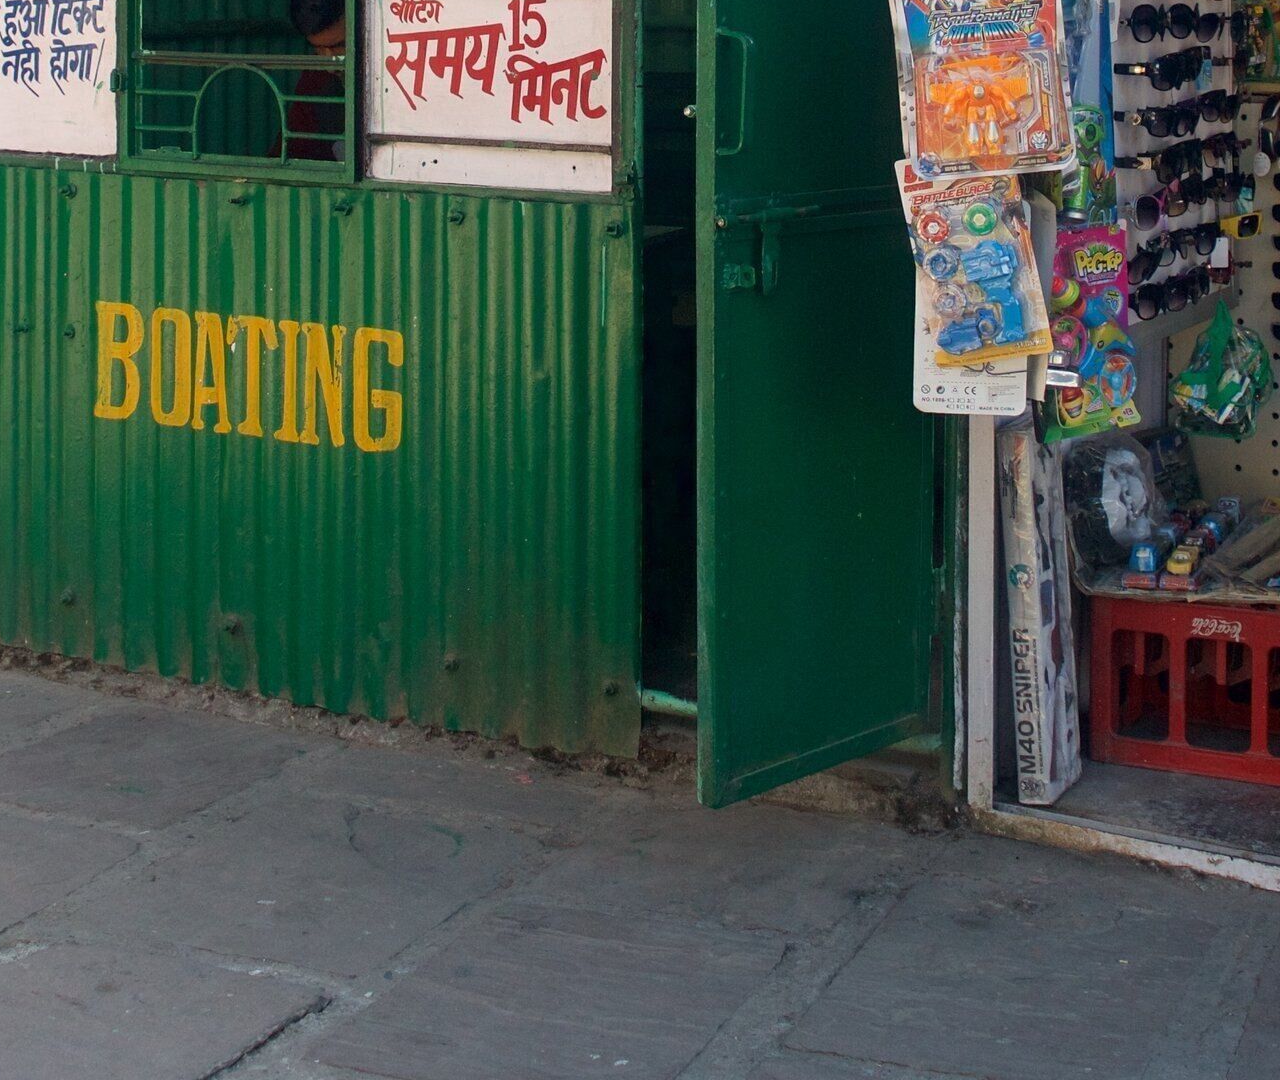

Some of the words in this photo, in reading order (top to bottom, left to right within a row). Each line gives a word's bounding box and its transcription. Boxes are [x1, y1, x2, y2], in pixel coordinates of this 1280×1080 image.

[1, 0, 49, 46] हुआ
[385, 22, 507, 111] समय
[503, 47, 608, 126] मिनट
[94, 301, 404, 452] BOATING
[1013, 627, 1034, 714] SNIPER
[1017, 719, 1036, 775] M40
